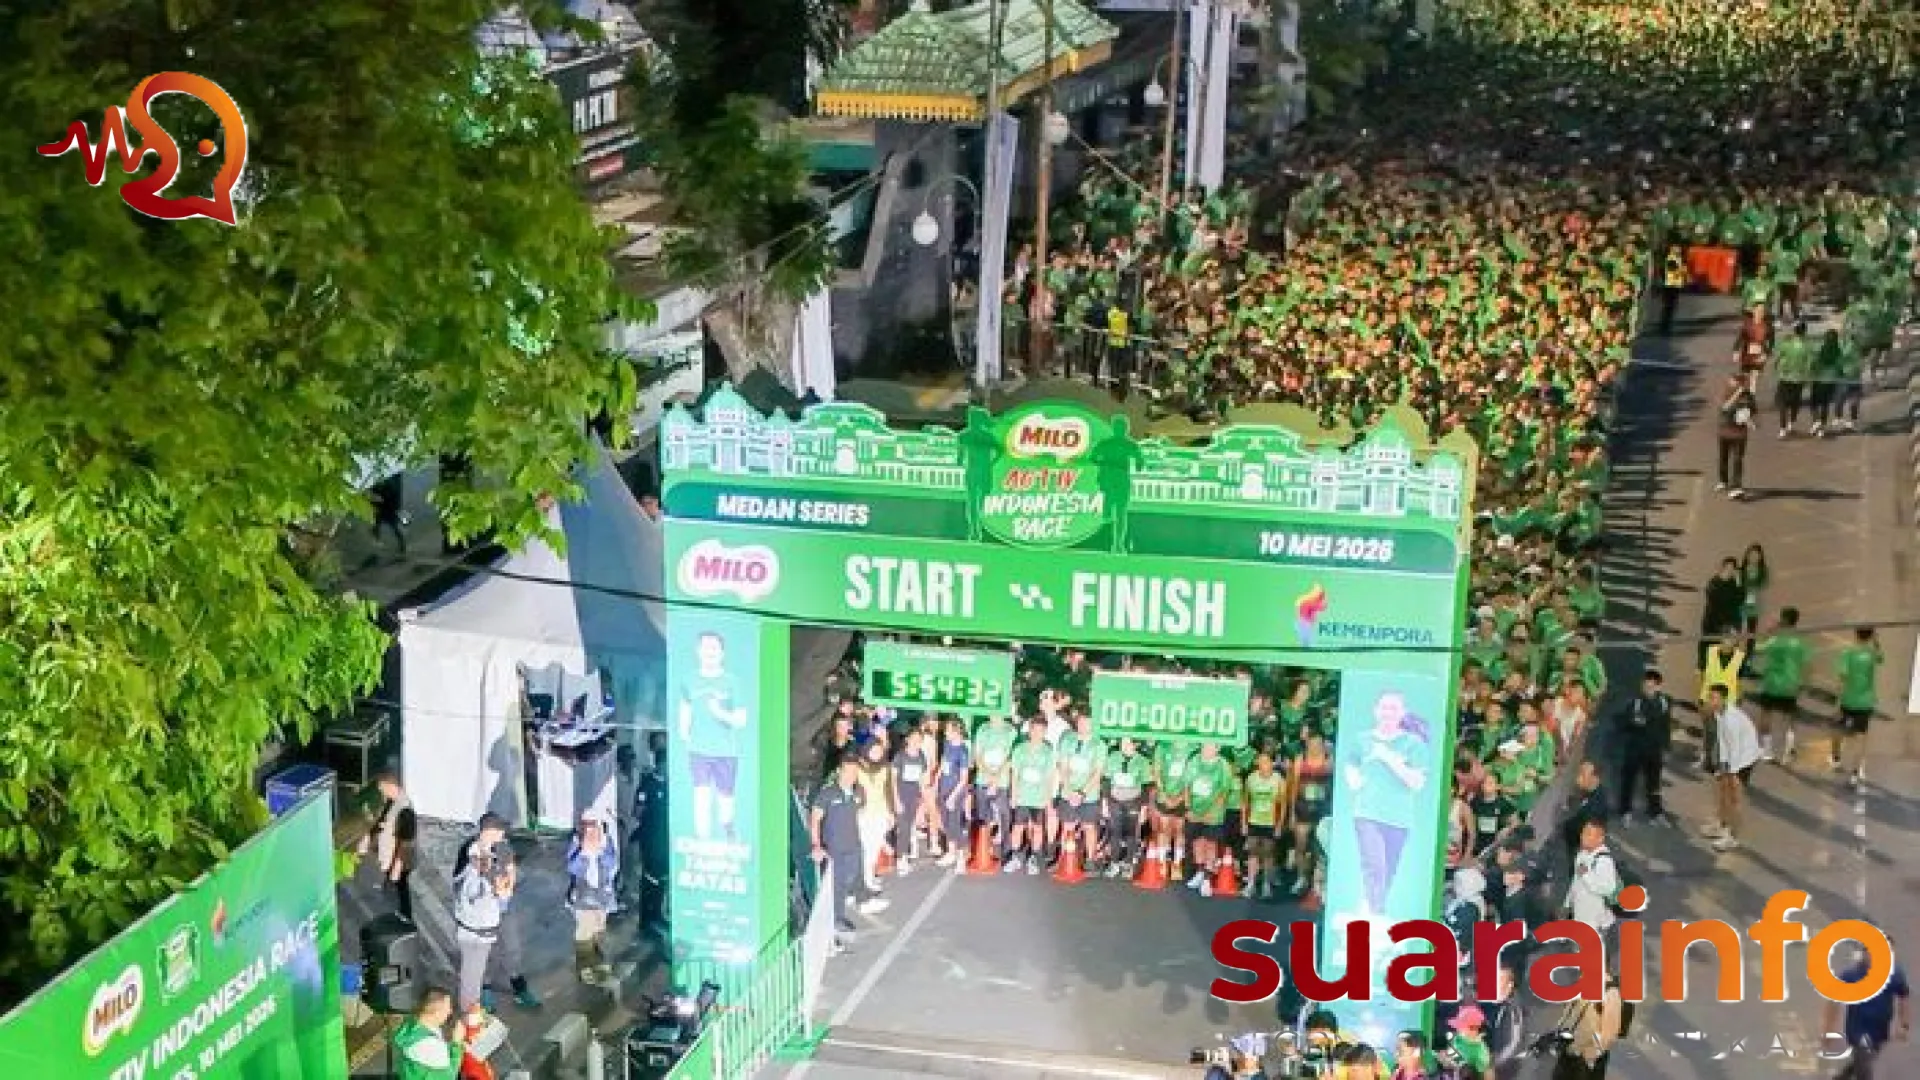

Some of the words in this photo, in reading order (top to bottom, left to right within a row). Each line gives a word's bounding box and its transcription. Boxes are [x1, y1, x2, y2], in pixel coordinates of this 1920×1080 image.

[1020, 425, 1081, 447] MILO
[717, 493, 796, 521] MEDAN
[798, 501, 871, 526] SERIES
[984, 490, 1105, 516] INDONESIA
[1012, 515, 1075, 541] RACE
[1259, 531, 1285, 555] 10
[1287, 533, 1331, 558] MEI
[1332, 536, 1395, 563] 2026
[692, 555, 769, 584] MILO
[844, 555, 983, 618] START
[1070, 571, 1228, 637] FINISH
[1317, 621, 1434, 645] KEMENPORA
[893, 671, 1001, 708] 5:54:32
[1101, 699, 1236, 735] 00:00:00
[153, 956, 267, 1069] INDONESIA
[270, 909, 319, 974] RACE
[93, 983, 138, 1036] MILO
